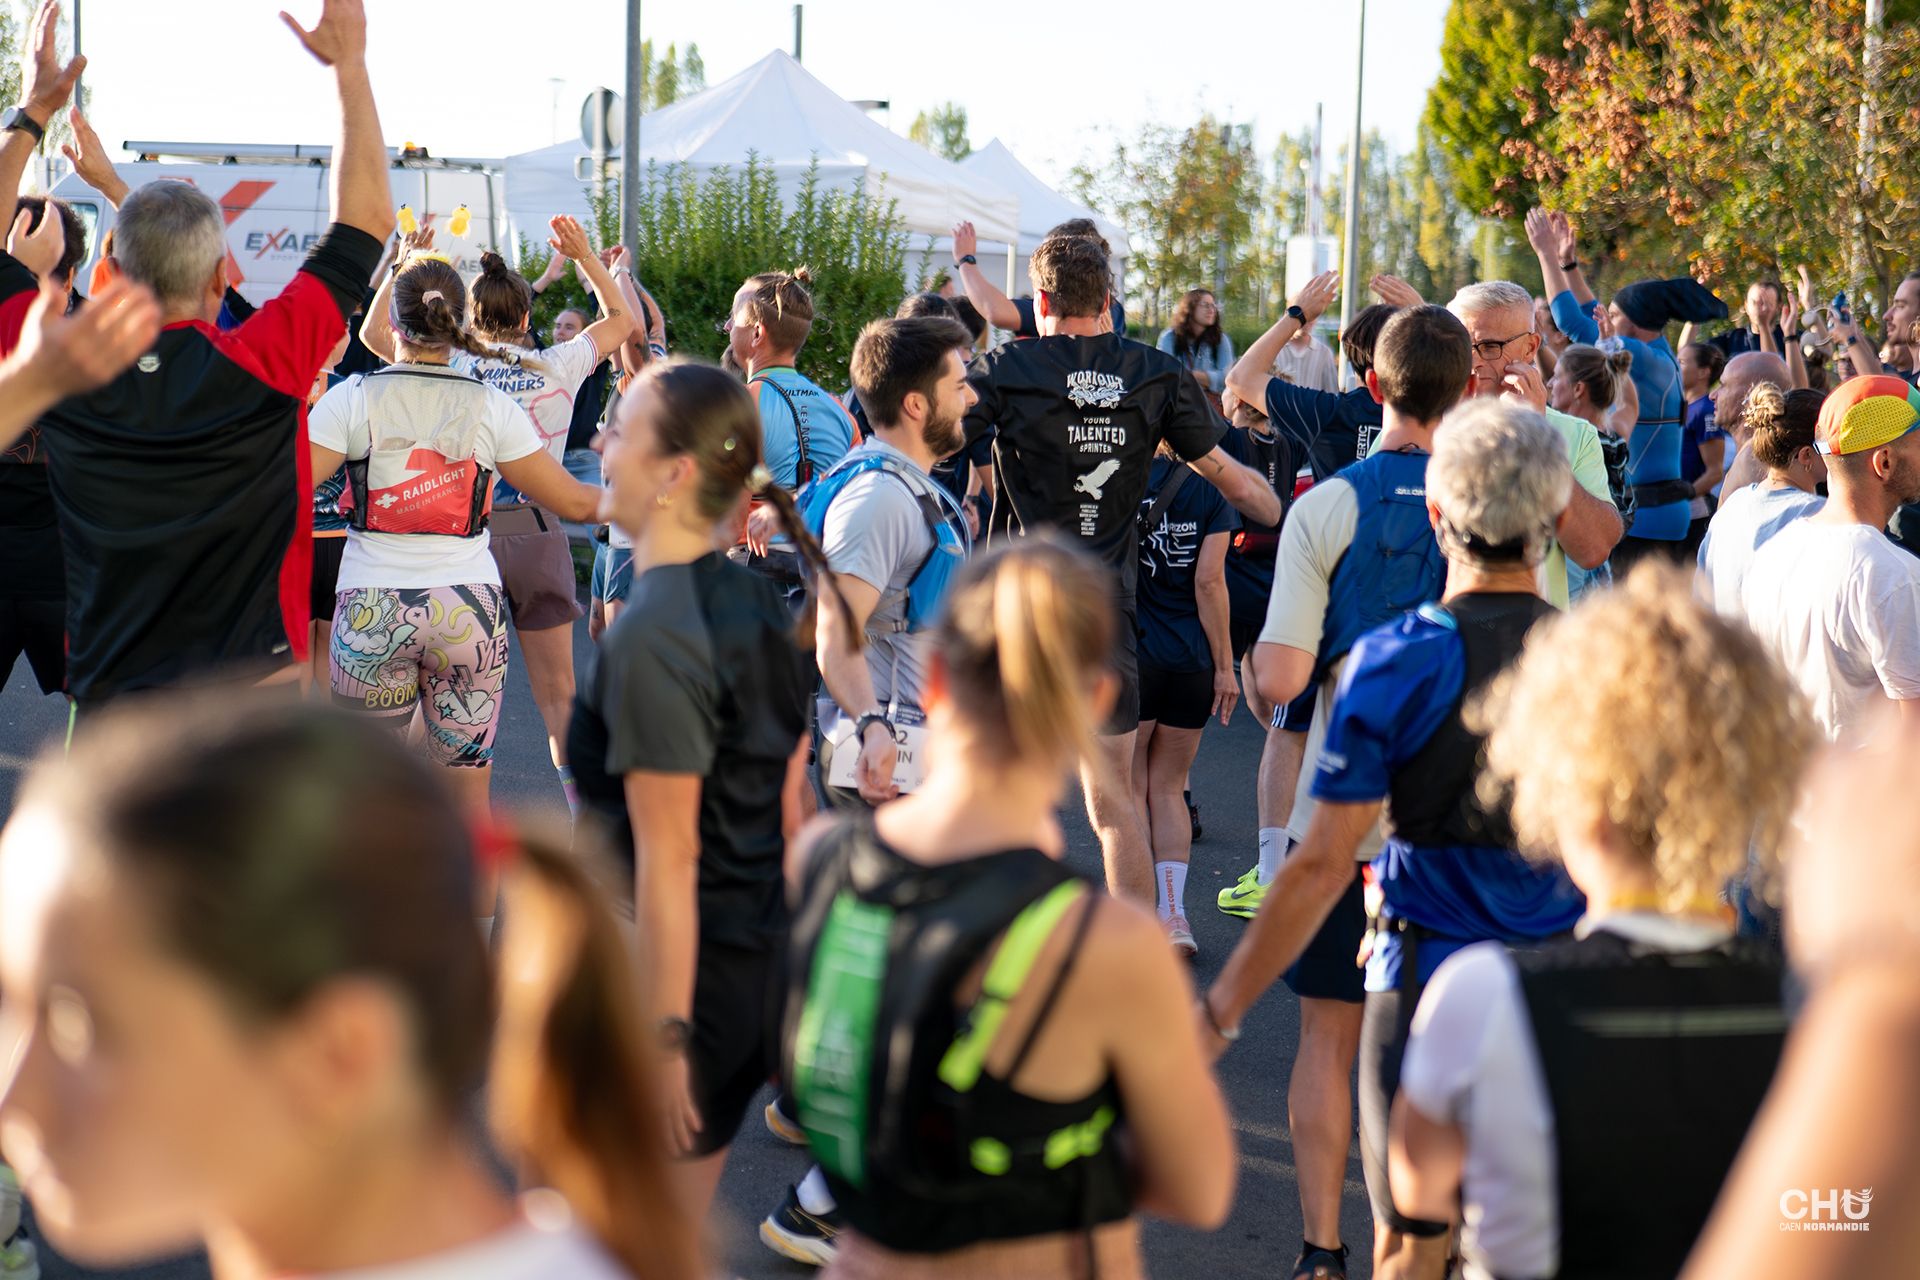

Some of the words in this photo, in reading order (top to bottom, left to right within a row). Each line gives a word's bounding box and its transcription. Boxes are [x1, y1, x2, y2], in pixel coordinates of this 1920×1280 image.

[1083, 417, 1111, 425] YOUNG
[1068, 426, 1126, 446] TALENTED
[1080, 442, 1112, 453] SPRINTER
[403, 468, 465, 501] RAIDLIGHT
[395, 501, 420, 515] MADE
[421, 497, 432, 506] IN
[365, 683, 418, 709] BOOM
